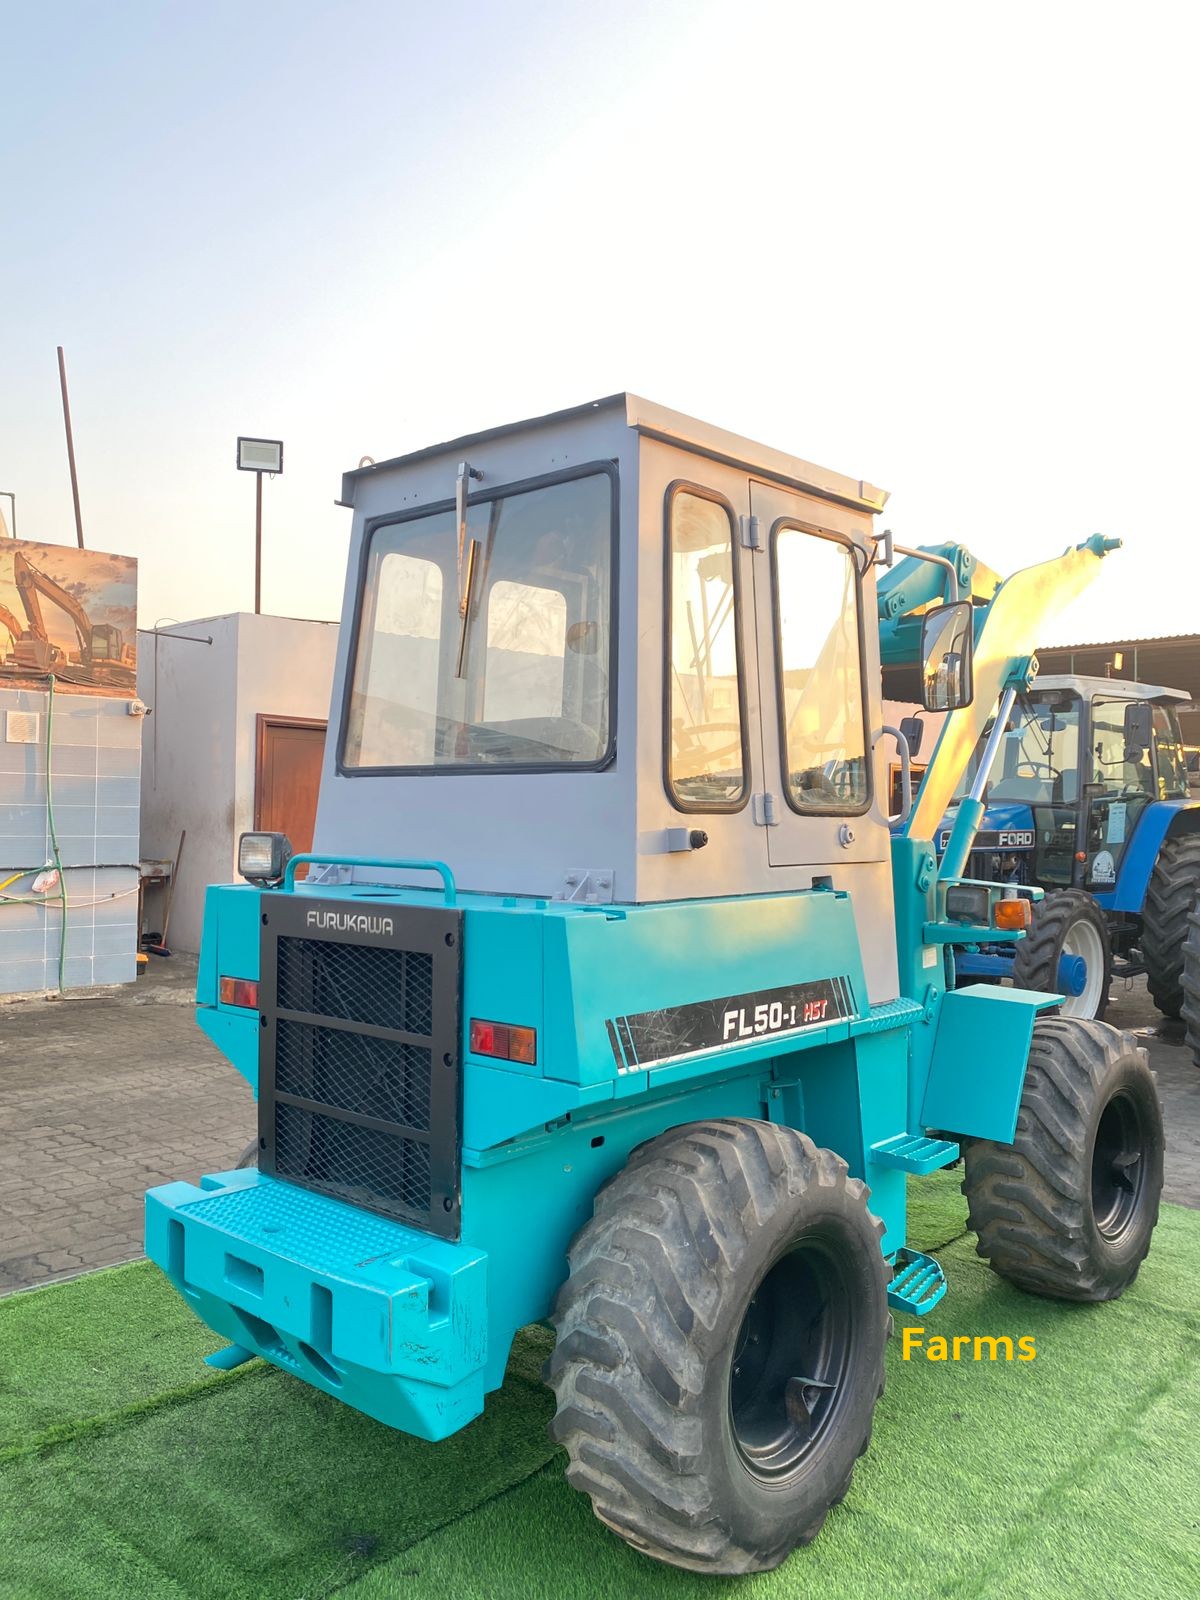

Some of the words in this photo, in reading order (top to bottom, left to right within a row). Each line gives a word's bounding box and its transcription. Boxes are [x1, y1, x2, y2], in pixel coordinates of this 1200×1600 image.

[999, 832, 1032, 846] FORD
[306, 911, 394, 936] FURUKAWA
[803, 999, 828, 1022] HST
